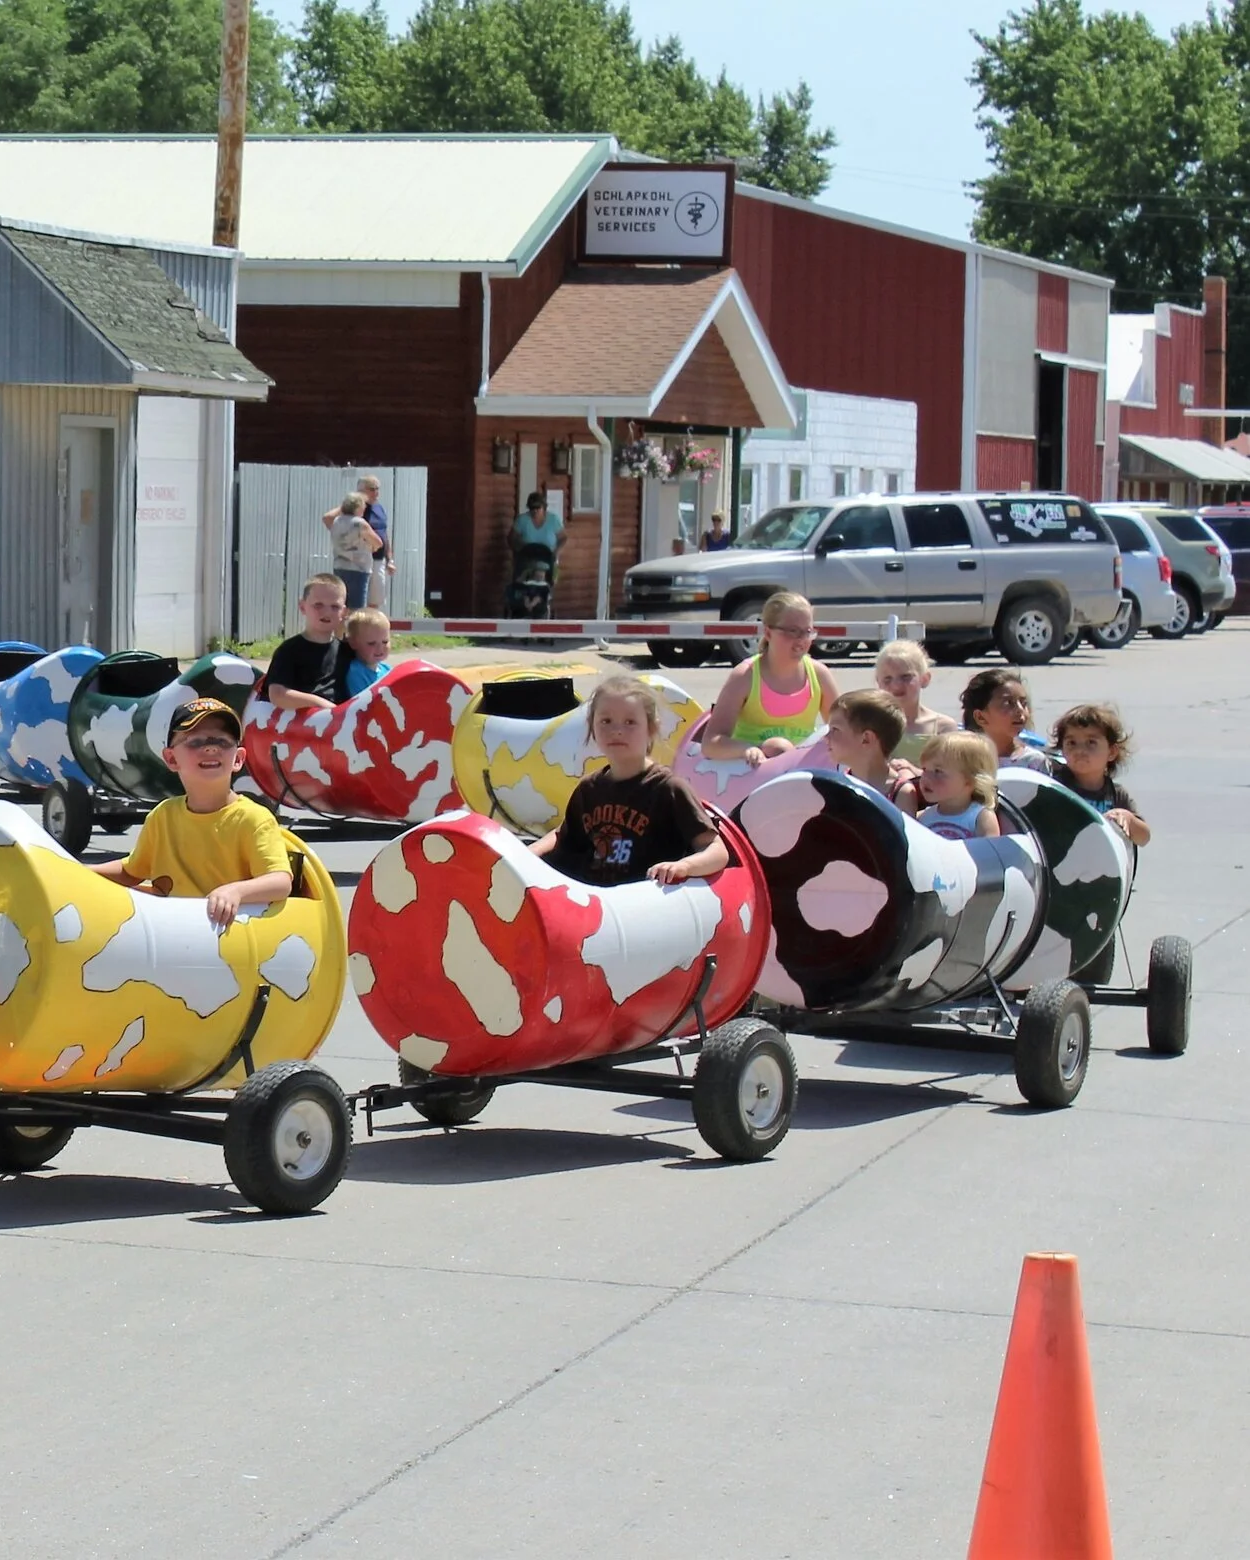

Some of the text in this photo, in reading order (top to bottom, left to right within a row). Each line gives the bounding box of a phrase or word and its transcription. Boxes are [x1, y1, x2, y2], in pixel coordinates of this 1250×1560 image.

[594, 190, 674, 202] SCHLAPKOHL
[594, 206, 670, 217] VETERINARY
[597, 221, 656, 233] SERVICES
[581, 804, 650, 837] ROOKIE
[606, 839, 633, 864] 36
